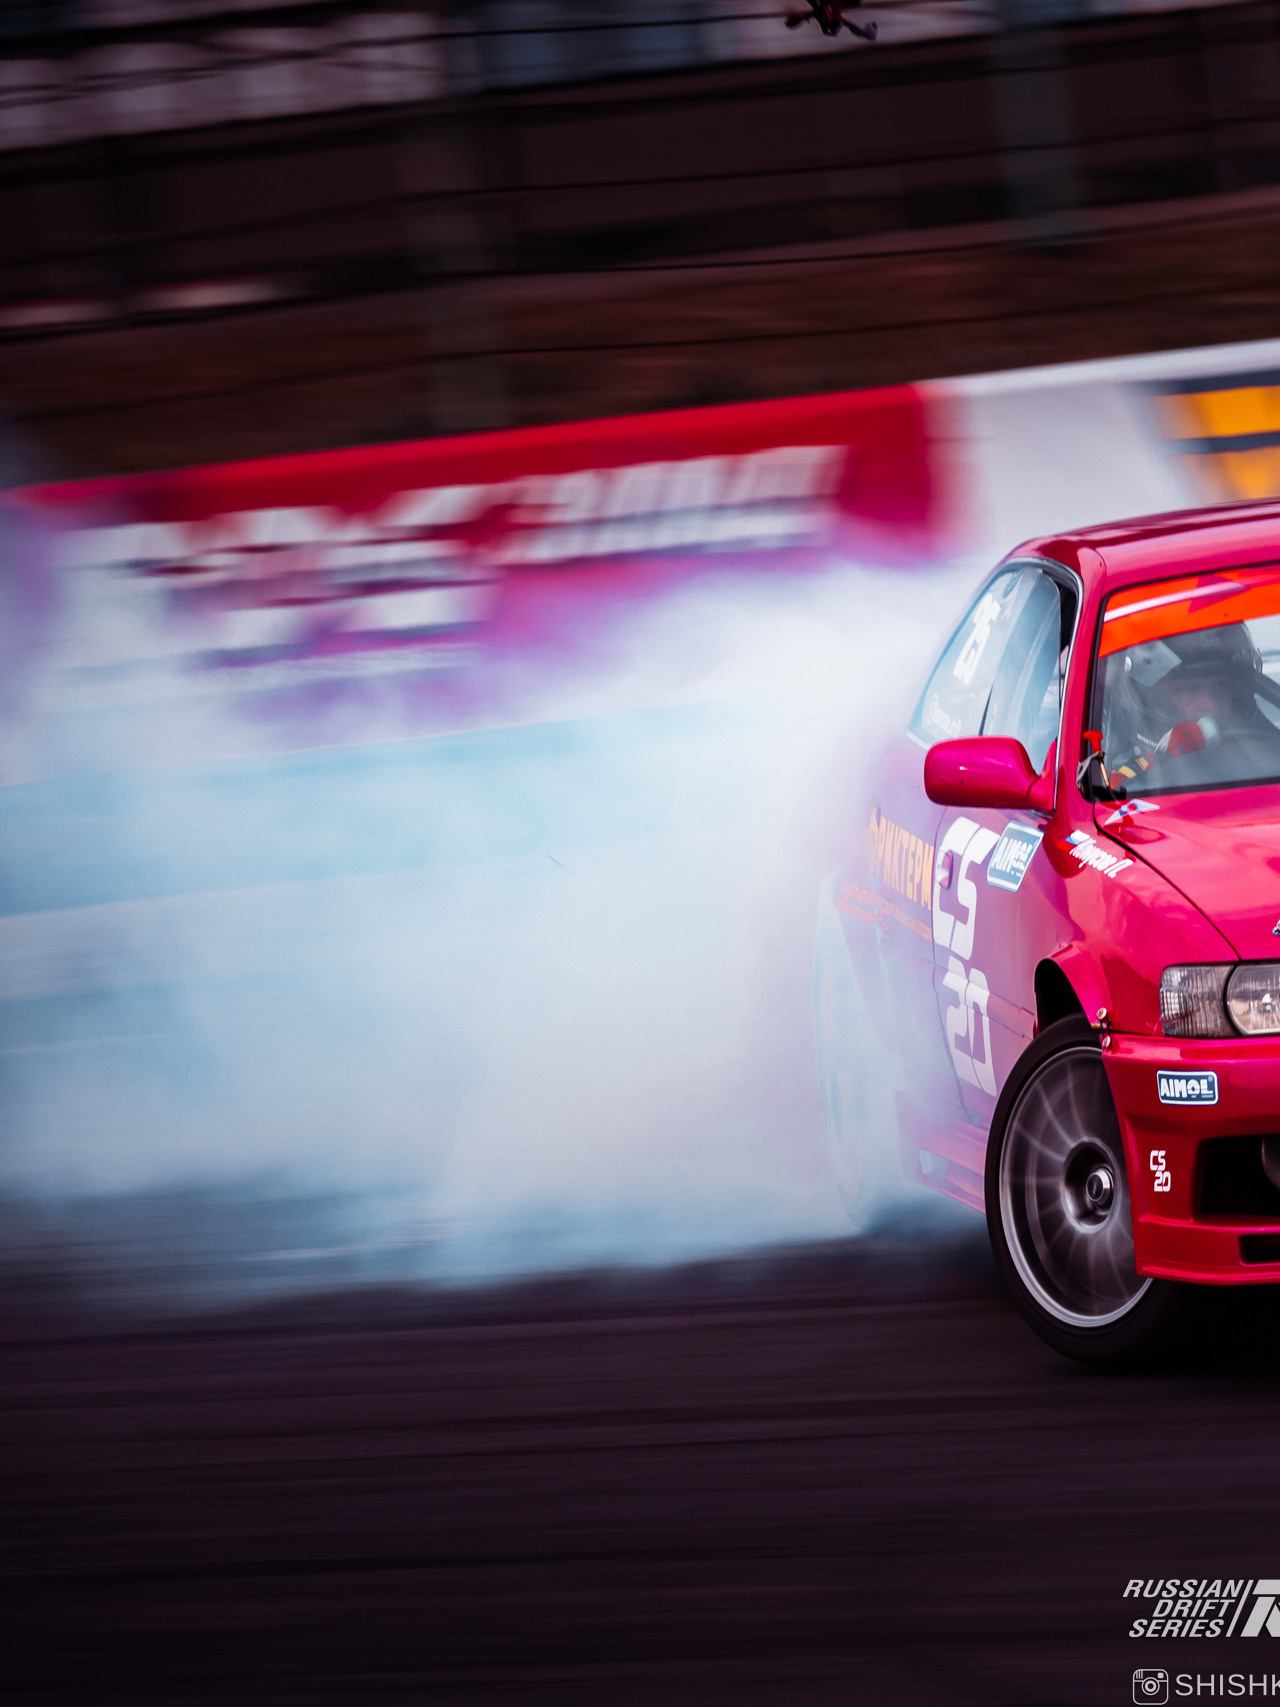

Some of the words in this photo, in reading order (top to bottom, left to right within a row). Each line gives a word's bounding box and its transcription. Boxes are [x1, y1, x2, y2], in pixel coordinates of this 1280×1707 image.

[932, 816, 1000, 960] CS
[1160, 1078, 1214, 1099] AIMOL
[1150, 1150, 1166, 1171] CS
[1154, 1171, 1171, 1192] 20
